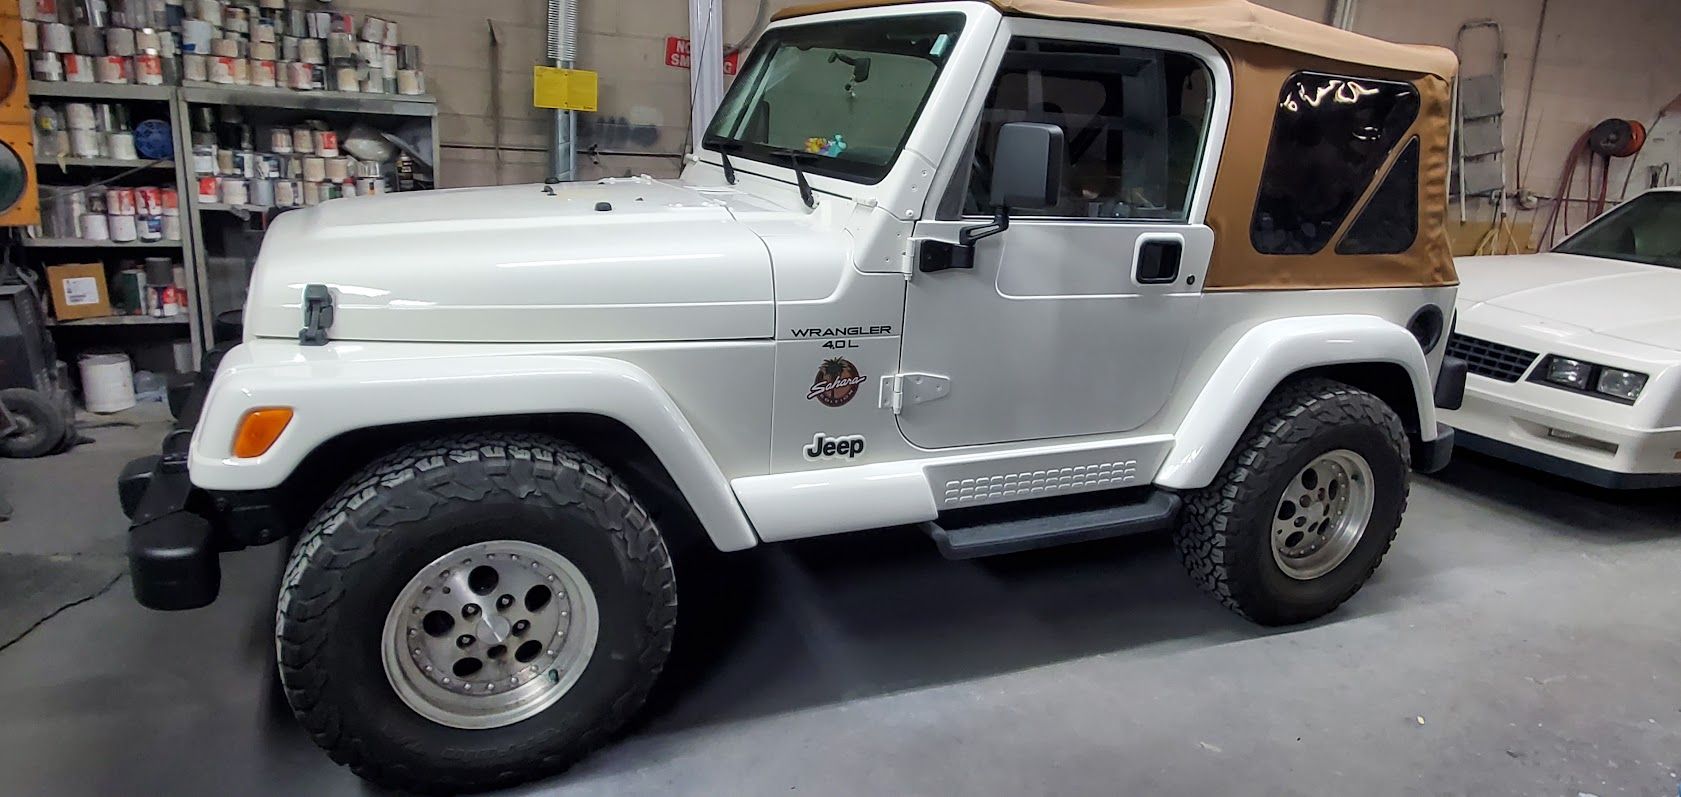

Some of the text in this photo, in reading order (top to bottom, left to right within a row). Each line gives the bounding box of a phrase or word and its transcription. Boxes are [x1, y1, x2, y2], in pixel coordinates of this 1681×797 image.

[790, 325, 892, 337] WRANGLER
[807, 374, 867, 400] Sahara
[806, 436, 865, 459] Jeep
